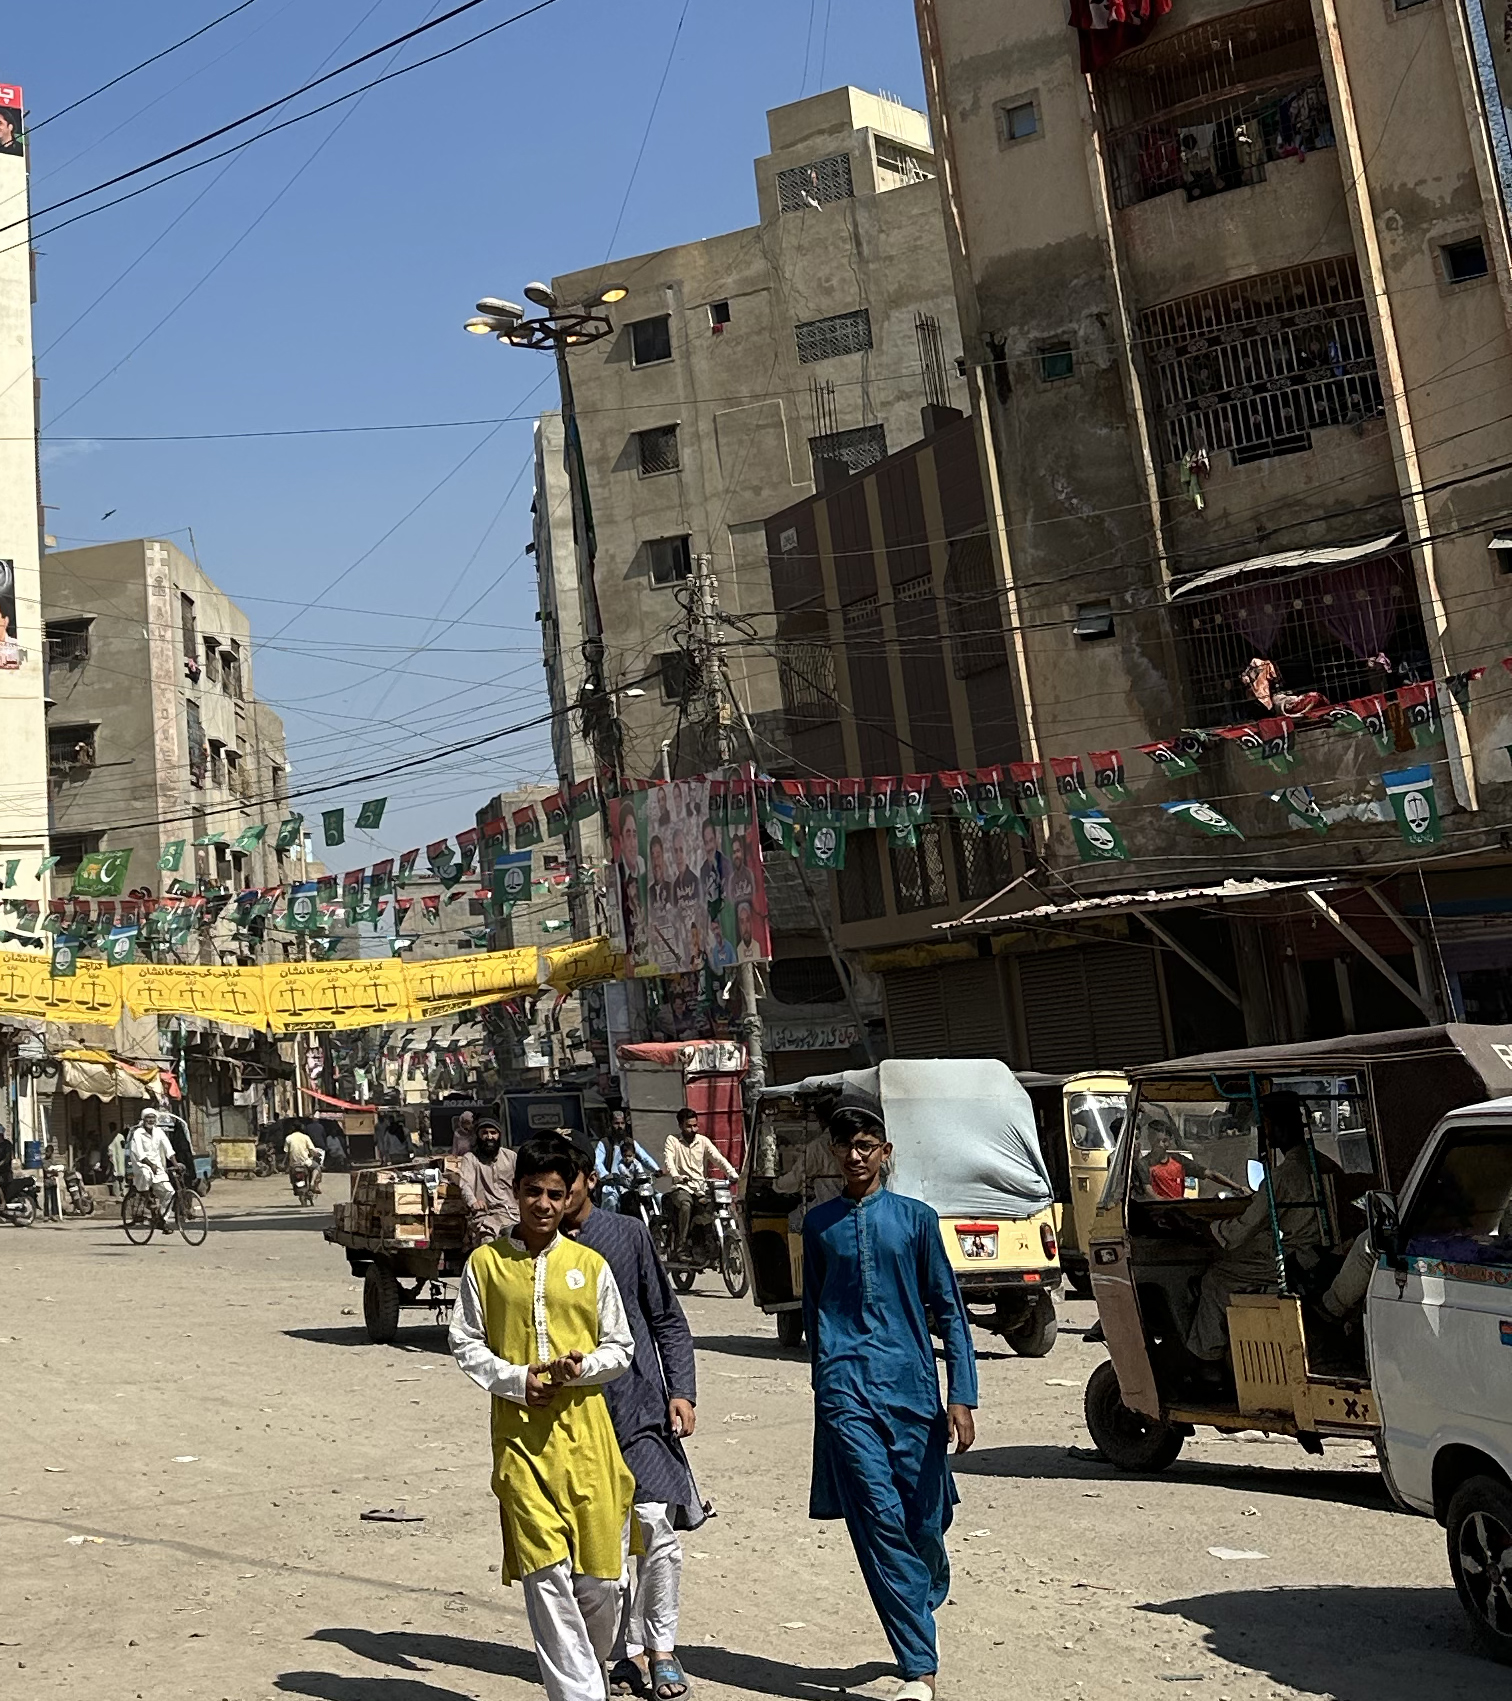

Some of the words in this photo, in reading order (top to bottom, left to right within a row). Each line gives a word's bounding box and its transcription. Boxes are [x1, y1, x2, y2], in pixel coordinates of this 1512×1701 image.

[139, 967, 165, 977] نشان
[165, 967, 174, 976] کا
[175, 968, 199, 979] جیت
[199, 968, 213, 978] کی
[280, 965, 306, 979] نشان
[306, 966, 316, 975] کا
[316, 966, 341, 976] جیت
[340, 963, 354, 974] کی
[354, 961, 383, 976] کراچی
[213, 968, 241, 980] کراچی
[443, 1100, 484, 1108] ROZGAR
